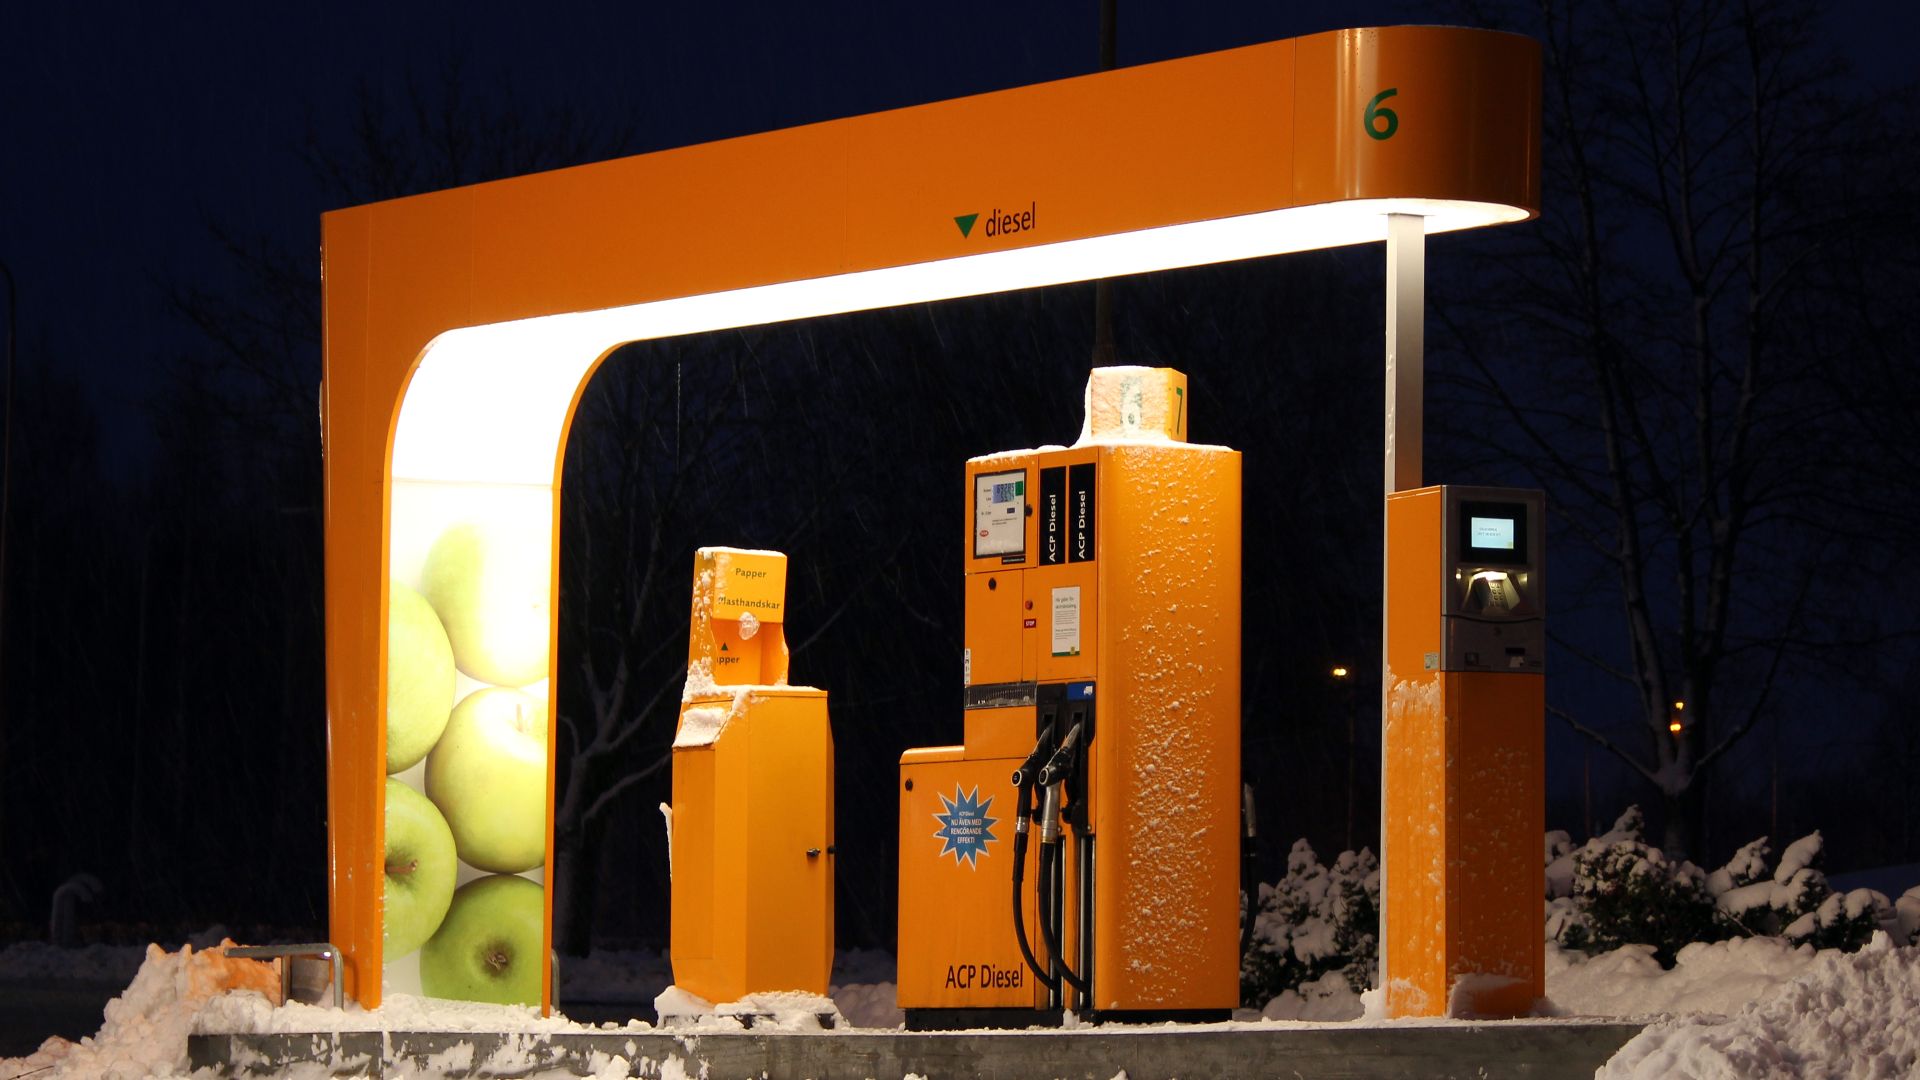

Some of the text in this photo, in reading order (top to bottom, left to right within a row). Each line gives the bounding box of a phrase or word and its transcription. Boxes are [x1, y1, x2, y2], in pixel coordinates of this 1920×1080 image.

[1363, 87, 1399, 141] 6
[985, 200, 1036, 238] diesel
[1176, 386, 1183, 436] 7
[1048, 493, 1057, 562] ACP Diesel
[1078, 489, 1086, 560] ACP Diesel
[735, 567, 767, 579] Papper
[950, 827, 982, 835] RENGÖRANDE
[959, 817, 971, 826] ÄVEN
[971, 818, 982, 826] MED
[944, 962, 1024, 989] ACP Diesel
